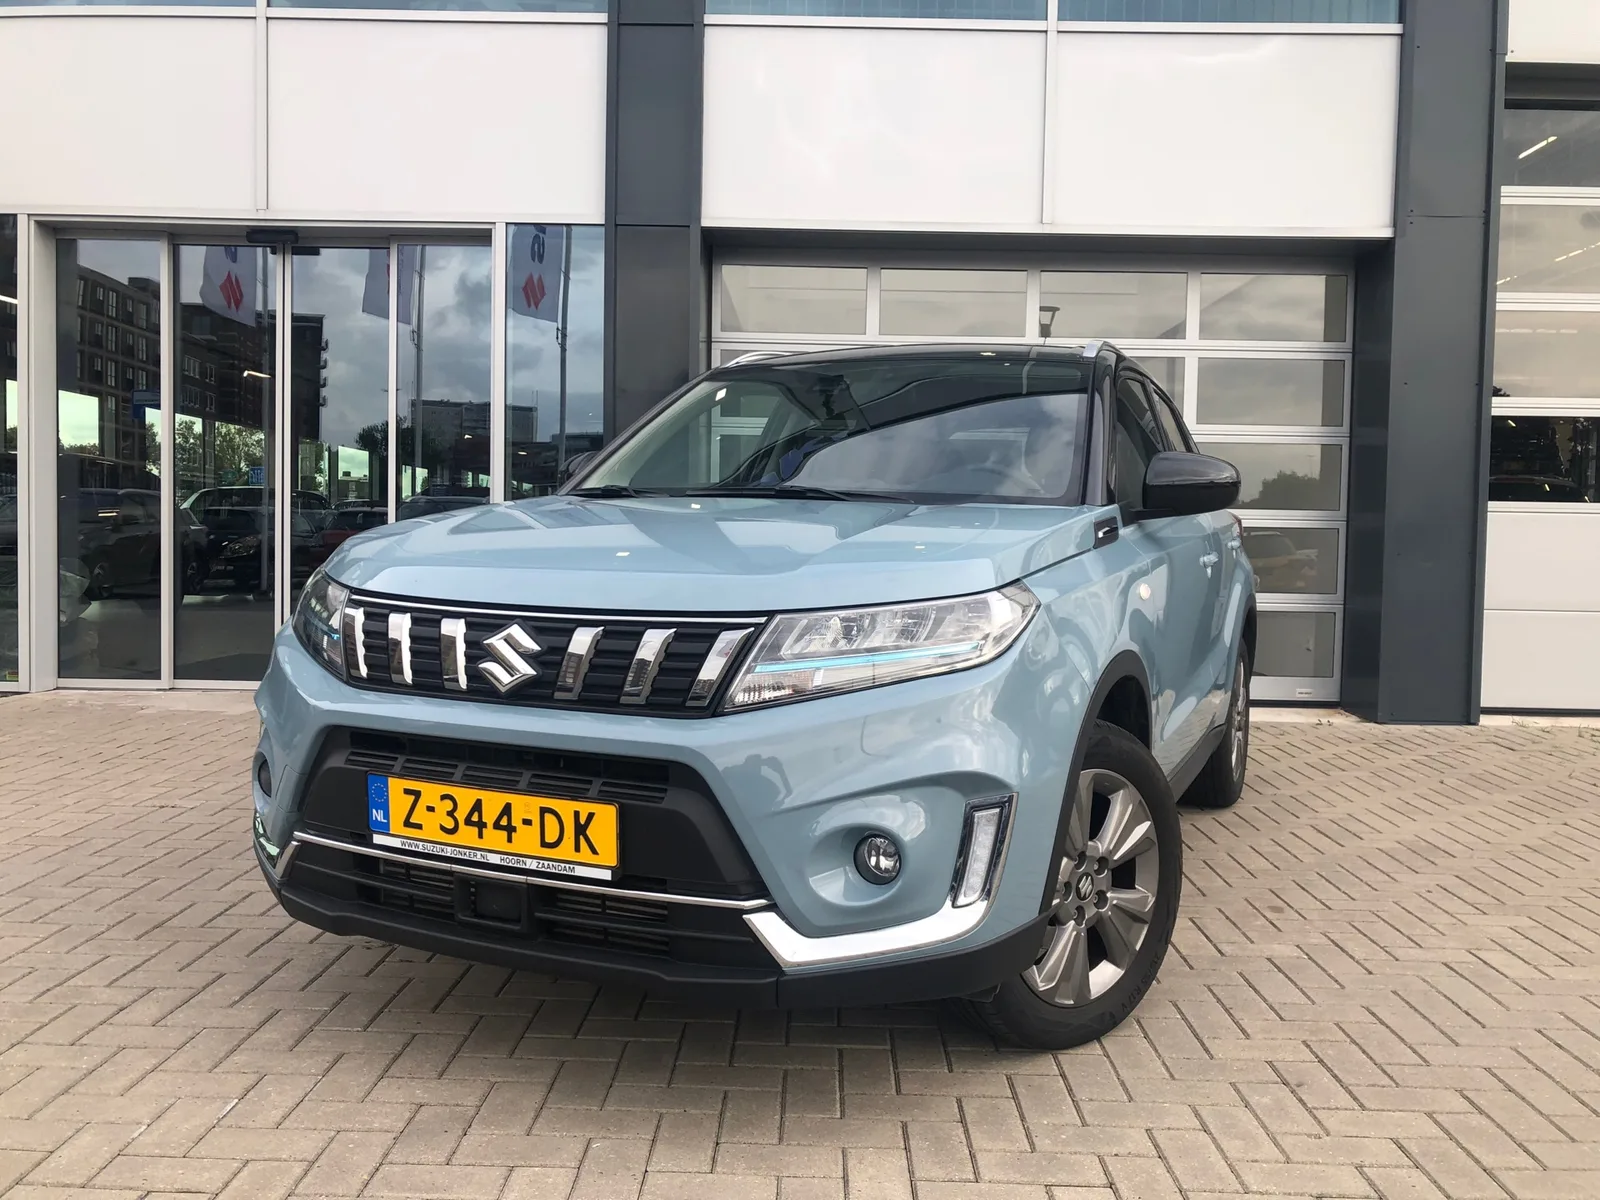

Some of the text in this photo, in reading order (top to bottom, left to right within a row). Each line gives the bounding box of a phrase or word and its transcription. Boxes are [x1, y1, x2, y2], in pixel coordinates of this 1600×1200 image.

[372, 808, 388, 823] NL
[402, 787, 600, 855] Z-344-DK
[400, 839, 490, 862] WWW.SUZUKI-JONKER.NL
[499, 855, 527, 867] HOORN
[535, 860, 576, 874] ZAANDAM
